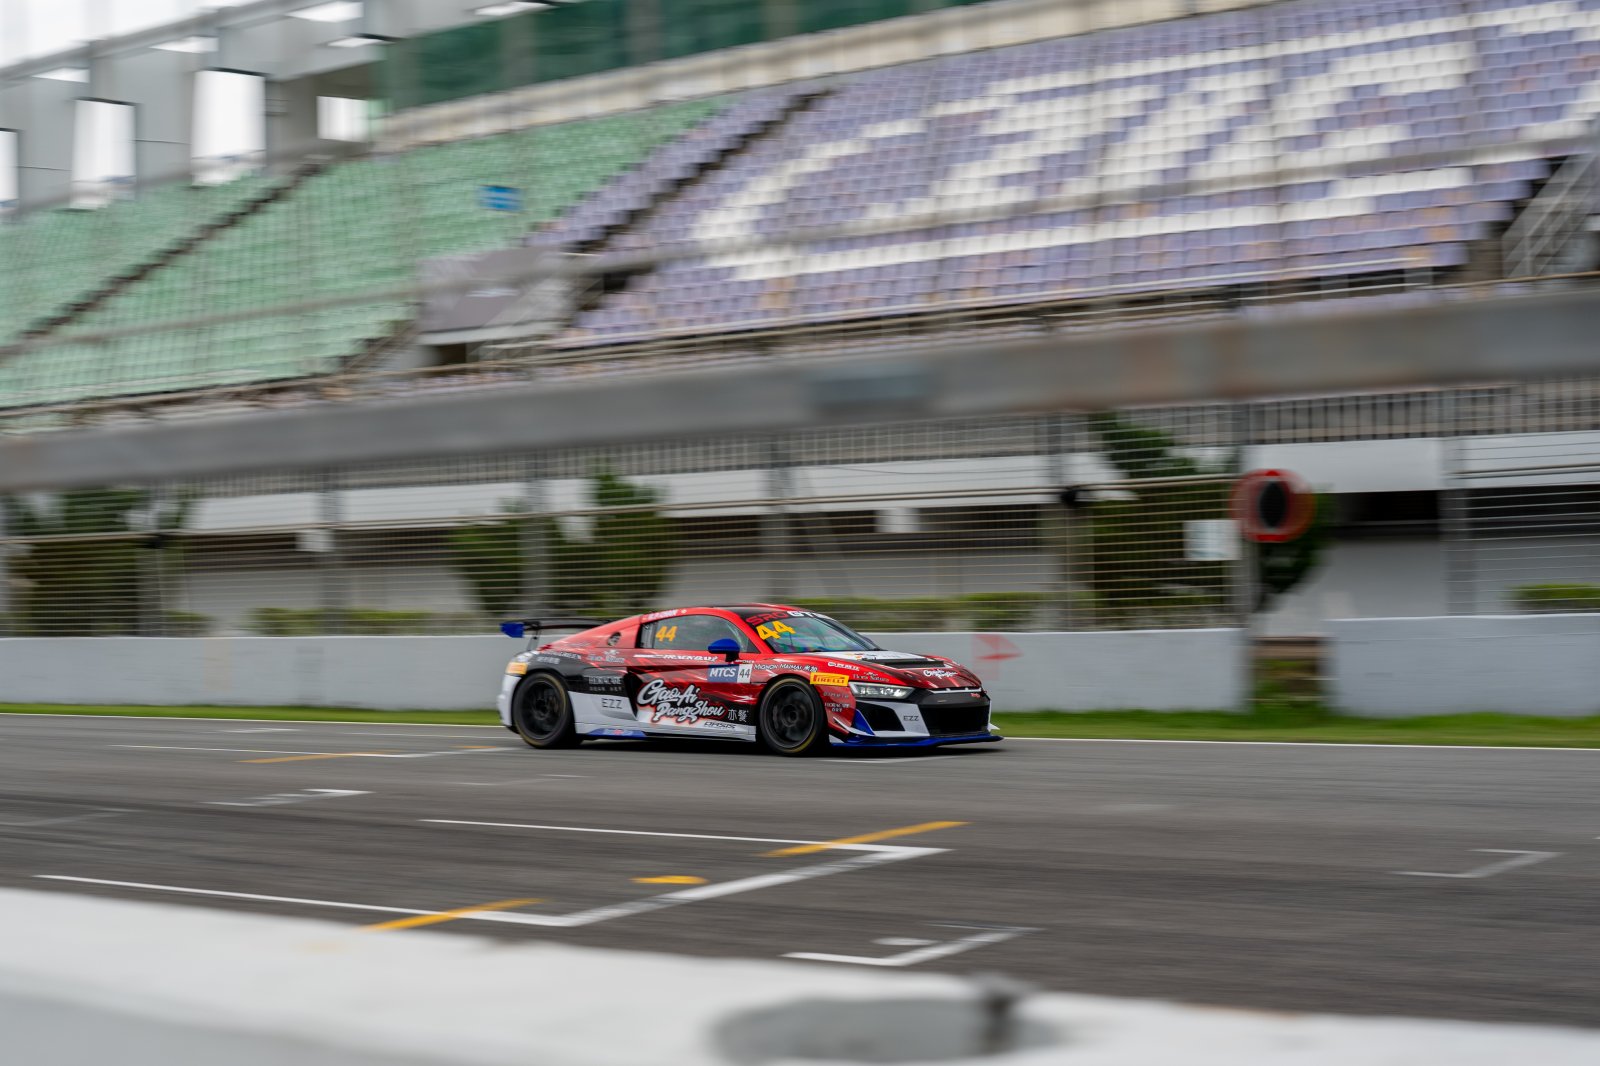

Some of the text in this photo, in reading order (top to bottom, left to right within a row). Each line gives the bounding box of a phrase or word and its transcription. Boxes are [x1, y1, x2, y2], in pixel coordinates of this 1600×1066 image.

[655, 625, 678, 642] 44
[756, 620, 796, 640] 44
[709, 667, 736, 678] MTCS
[739, 668, 751, 678] 44
[813, 674, 845, 684] PIRELLI
[602, 698, 623, 709] EZZ
